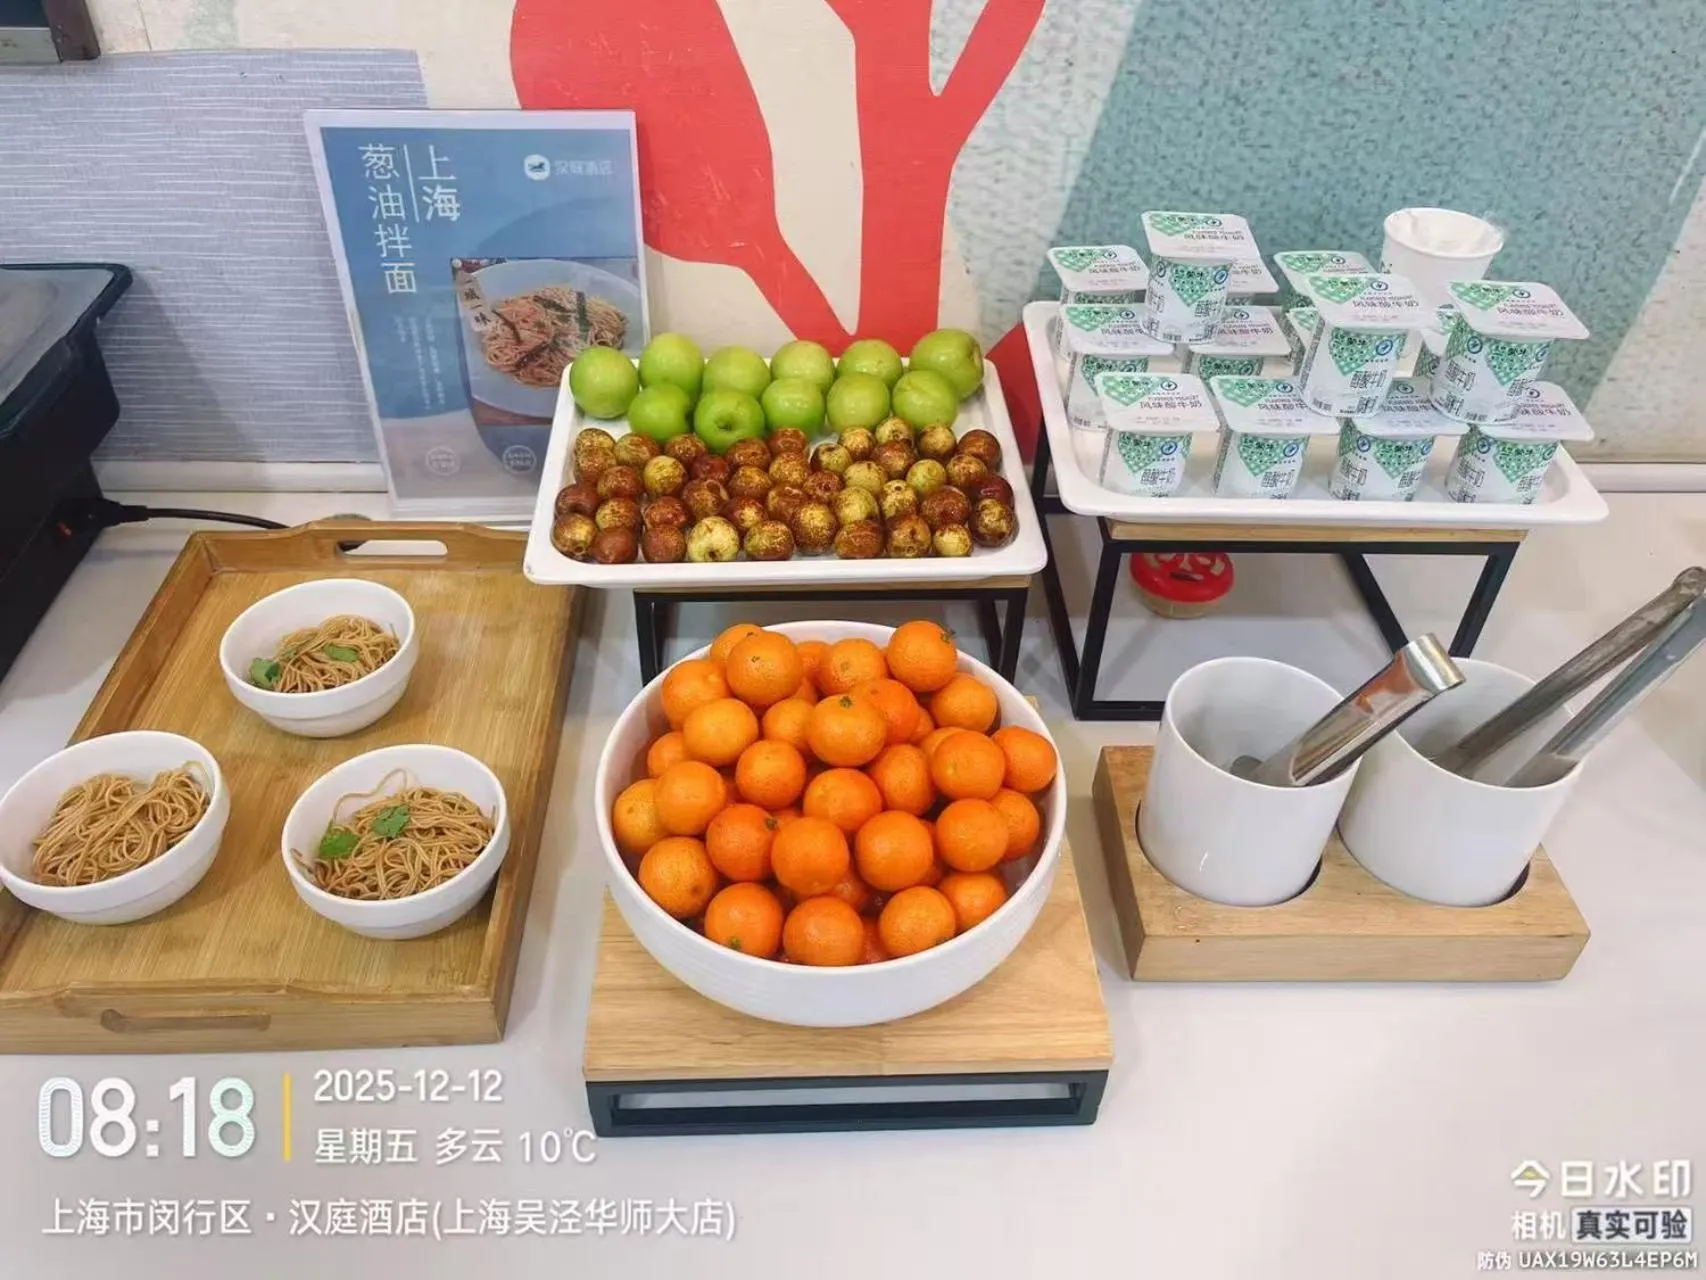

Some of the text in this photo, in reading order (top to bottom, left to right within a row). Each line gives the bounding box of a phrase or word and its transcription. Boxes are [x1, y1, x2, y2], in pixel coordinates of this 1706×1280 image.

[358, 143, 416, 294] 葱油拌面
[418, 145, 462, 223] 上海
